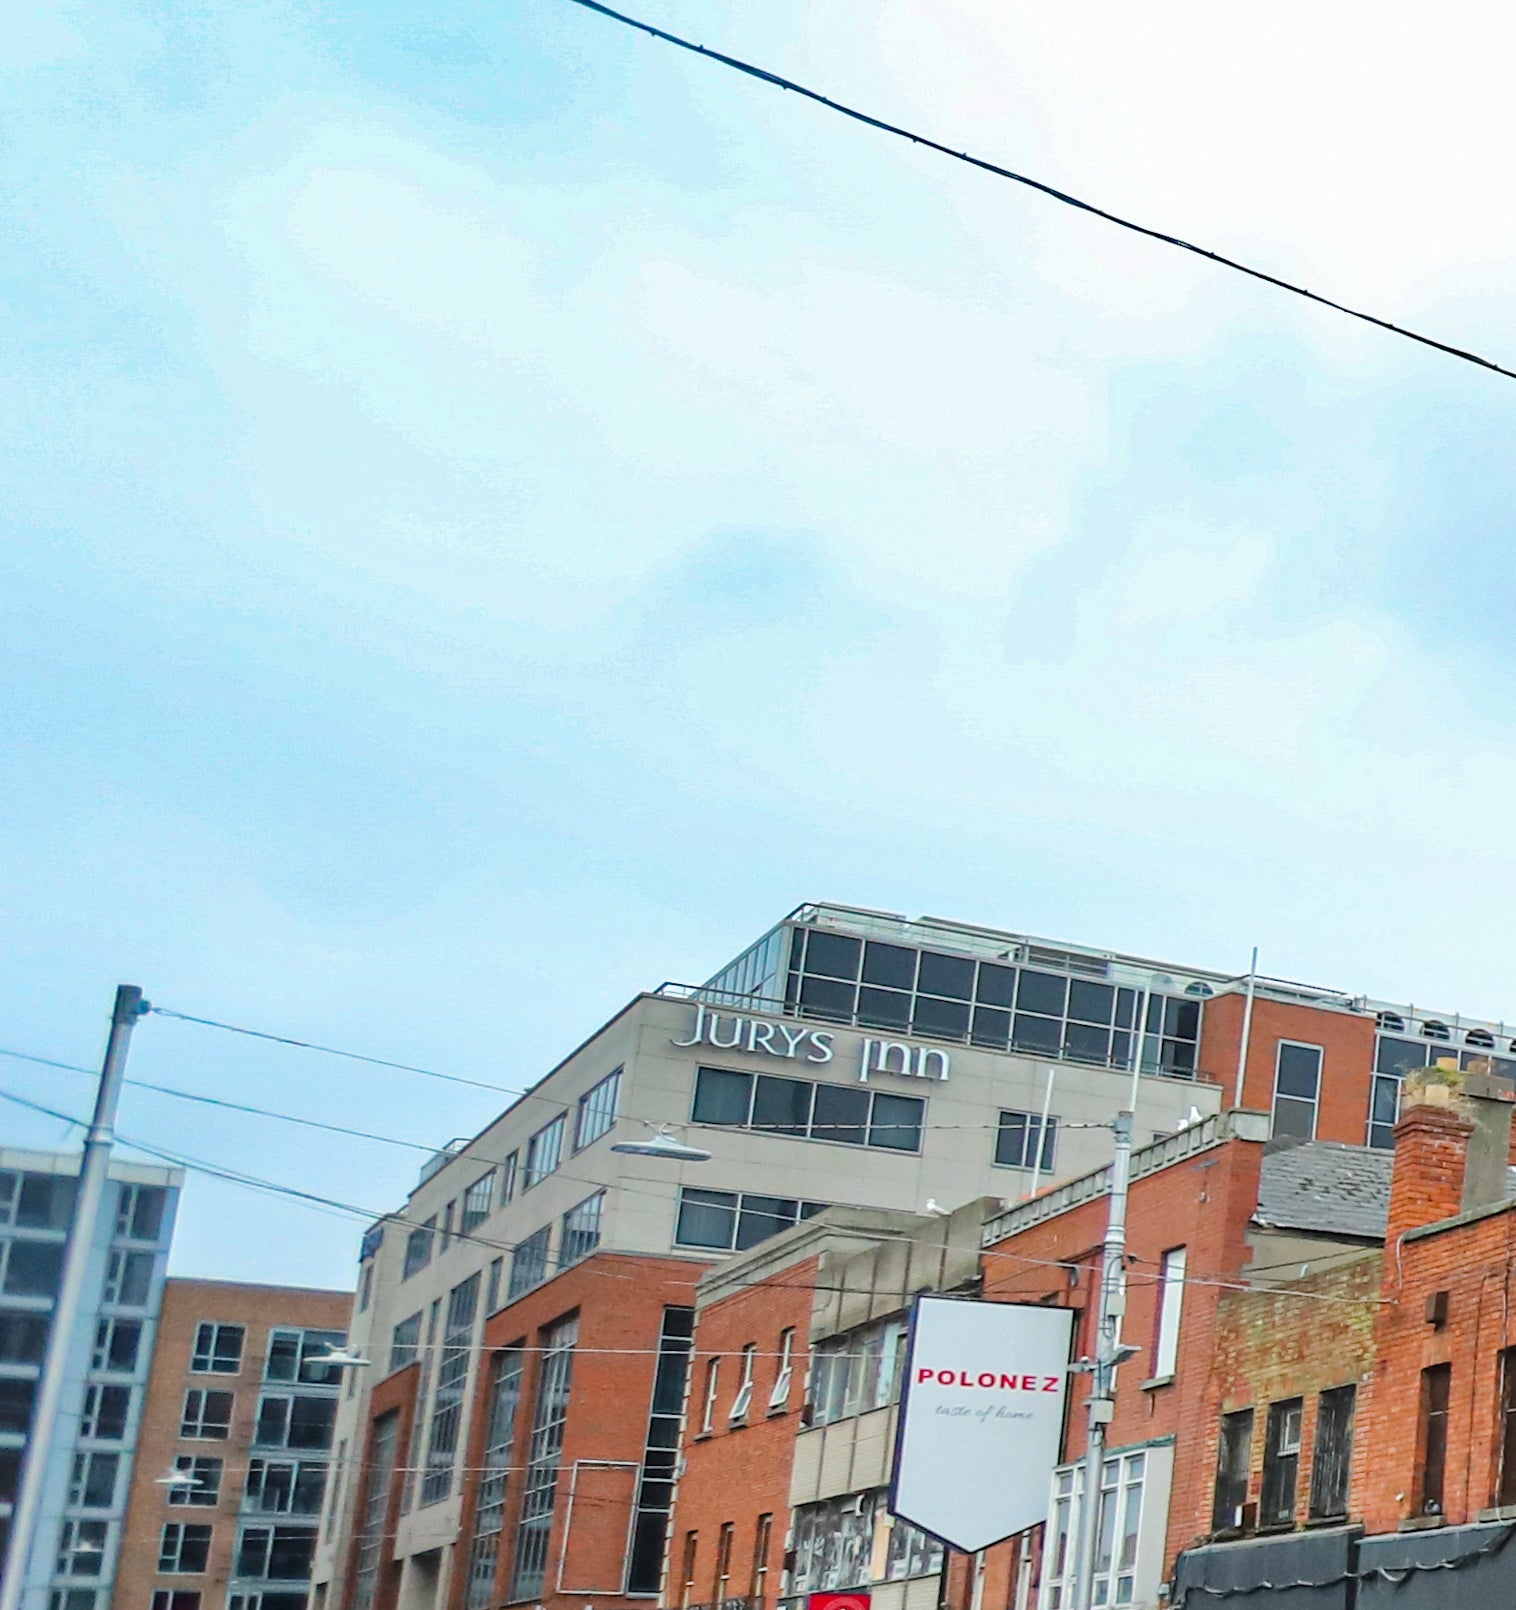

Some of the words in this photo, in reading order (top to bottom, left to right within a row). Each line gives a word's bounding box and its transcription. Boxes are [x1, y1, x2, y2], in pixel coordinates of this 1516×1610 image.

[918, 1368, 1060, 1392] POLONEZ
[935, 1405, 972, 1416] taste
[975, 1405, 994, 1422] of
[995, 1406, 1035, 1419] home
